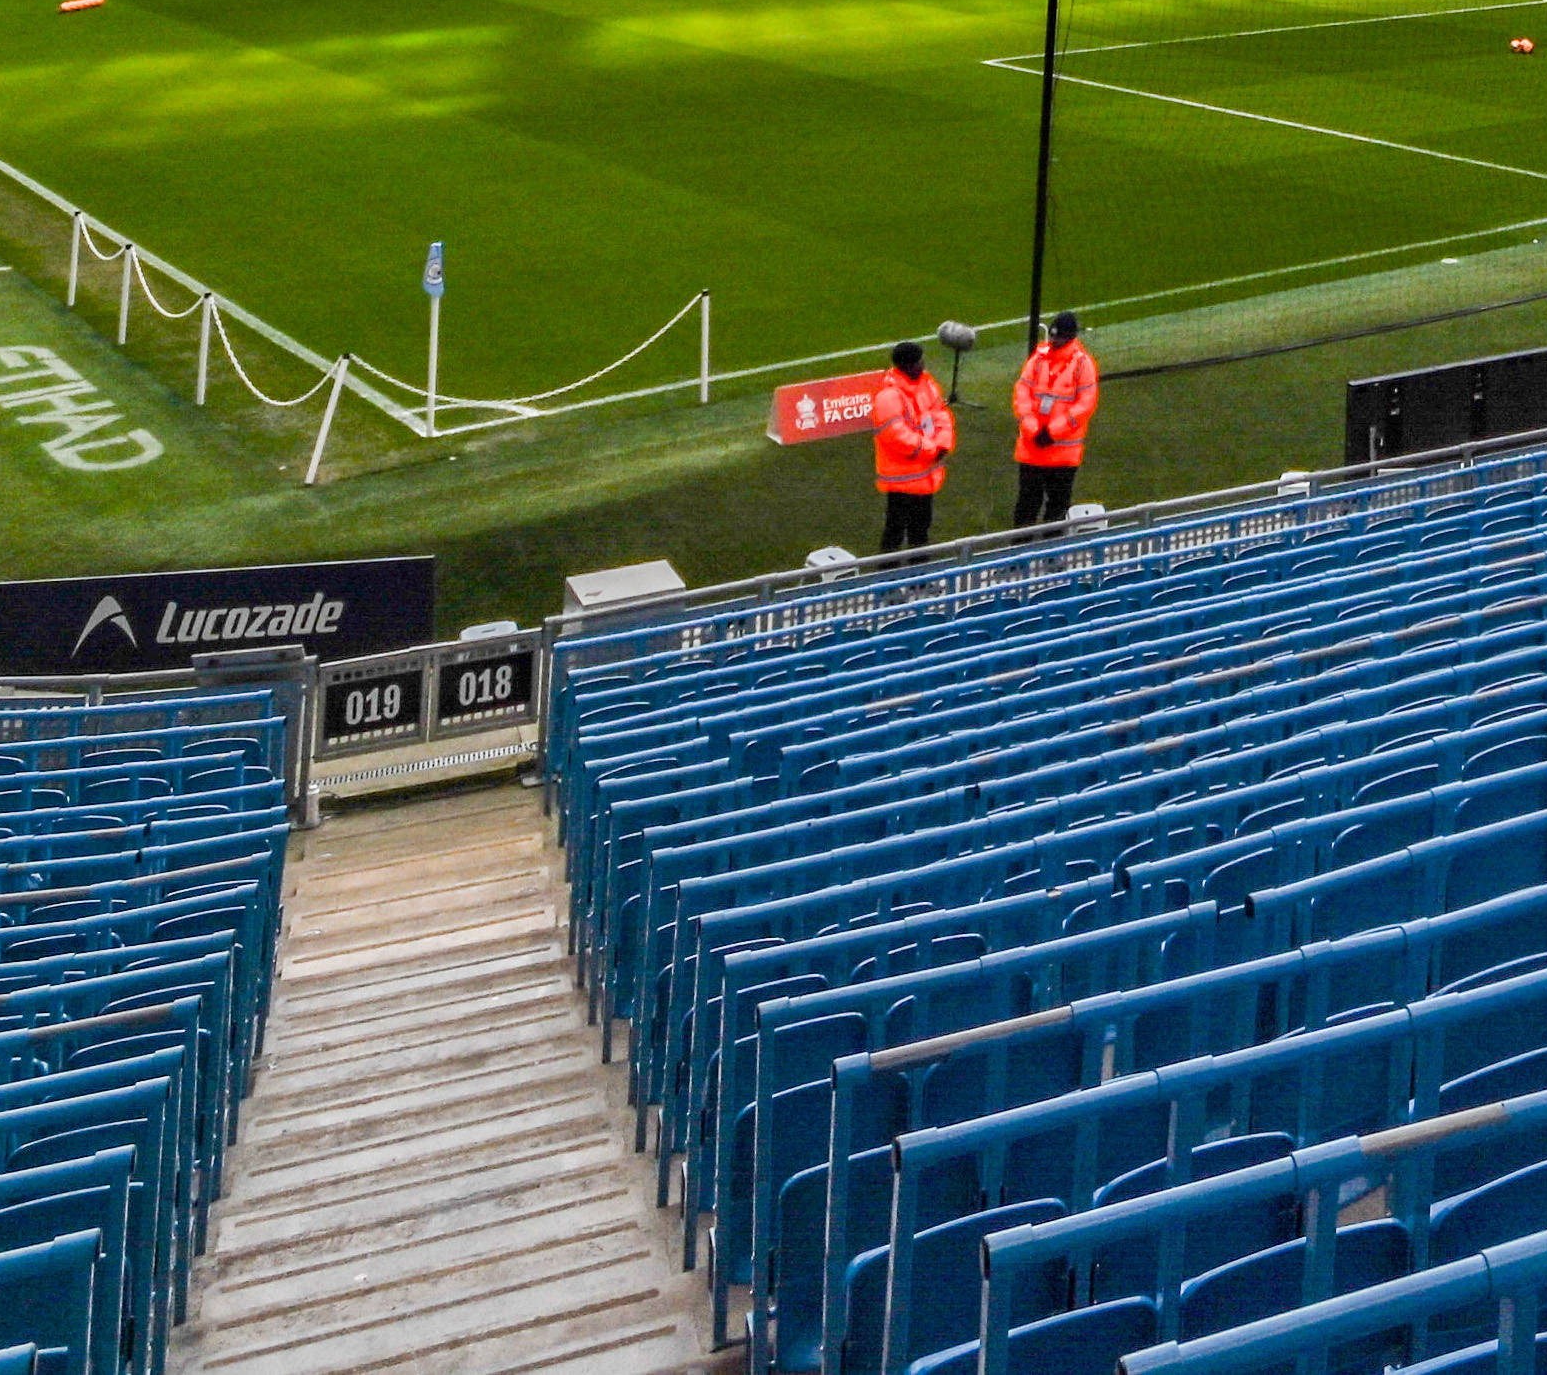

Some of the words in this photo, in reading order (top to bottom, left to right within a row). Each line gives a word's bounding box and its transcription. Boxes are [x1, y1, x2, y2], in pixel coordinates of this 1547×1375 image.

[822, 392, 872, 410] Emirates
[824, 411, 842, 424] FA
[843, 404, 873, 420] CUP
[156, 592, 344, 644] Lucozade
[345, 683, 401, 726] 019
[458, 664, 513, 707] 018
